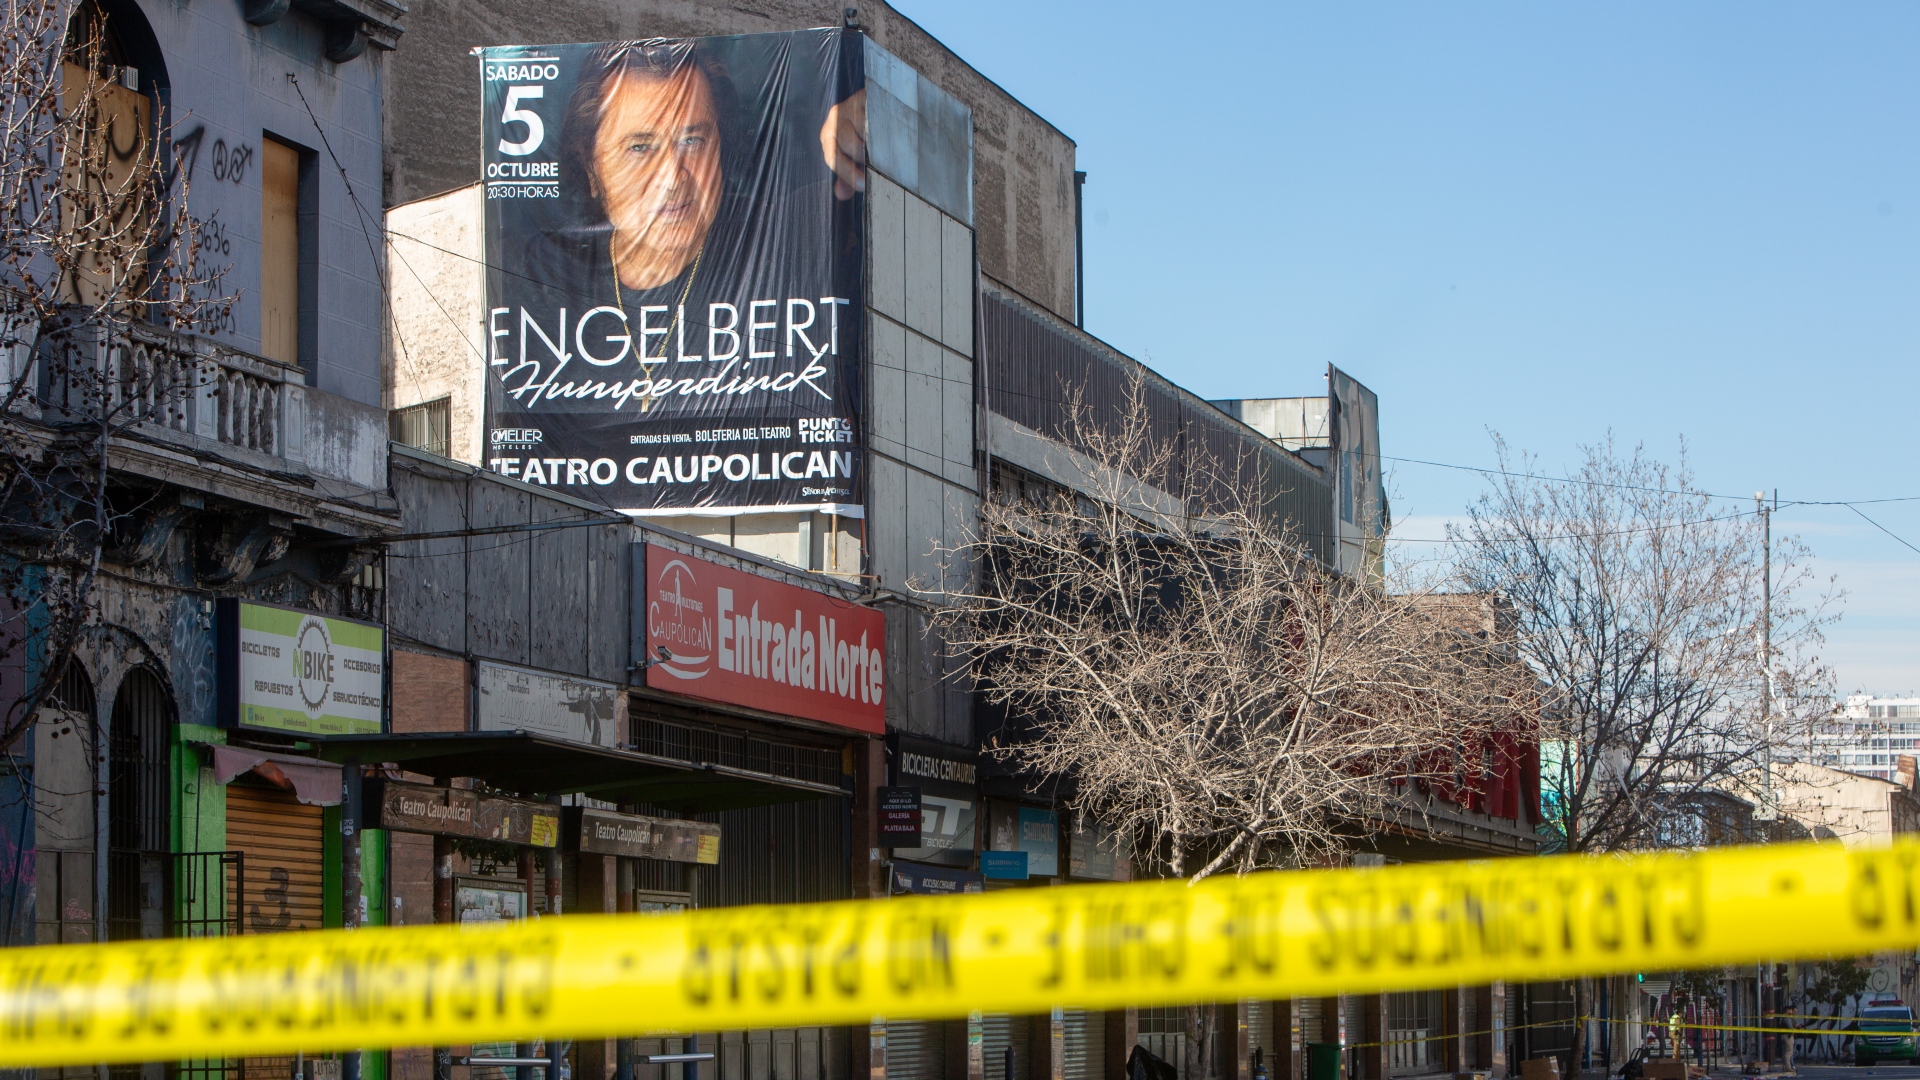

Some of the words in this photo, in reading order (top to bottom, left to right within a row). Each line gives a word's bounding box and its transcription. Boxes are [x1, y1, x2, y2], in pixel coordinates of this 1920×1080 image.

[486, 64, 559, 81] SABADO
[498, 85, 545, 156] 5
[487, 162, 559, 178] OCTUBRE
[487, 186, 516, 200] 20:30
[517, 186, 560, 199] HORAS
[489, 296, 850, 367] ENGELBERT
[502, 342, 833, 411] Humperdinck
[798, 417, 851, 431] PUNTO
[491, 428, 543, 443] OMELIER
[630, 435, 662, 445] ENTRADAS
[662, 434, 671, 444] EN
[695, 429, 741, 442] BOLETERIA
[743, 427, 759, 441] DEL
[760, 426, 792, 440] TEATRO
[798, 430, 853, 443] TICKET
[489, 456, 619, 486] TEATRO
[625, 451, 852, 484] CAUPOLICAN
[650, 601, 712, 652] CAUPOLICAN
[241, 641, 281, 659] BICICLETAS
[717, 586, 816, 692] Entrada
[819, 614, 883, 706] Norte
[343, 658, 381, 675] ACCESORIOS
[254, 680, 294, 697] REPUESTOS
[506, 682, 530, 696] Importadora
[332, 691, 358, 705] SERVICIO
[358, 692, 380, 708] TÉCNICO
[902, 752, 940, 779] BICICLETAS
[940, 759, 977, 785] CENTAURUS
[400, 796, 426, 817] Teatro
[427, 800, 471, 823] Caupolicán
[595, 821, 616, 841] Teatro
[617, 824, 650, 847] Caupolicán
